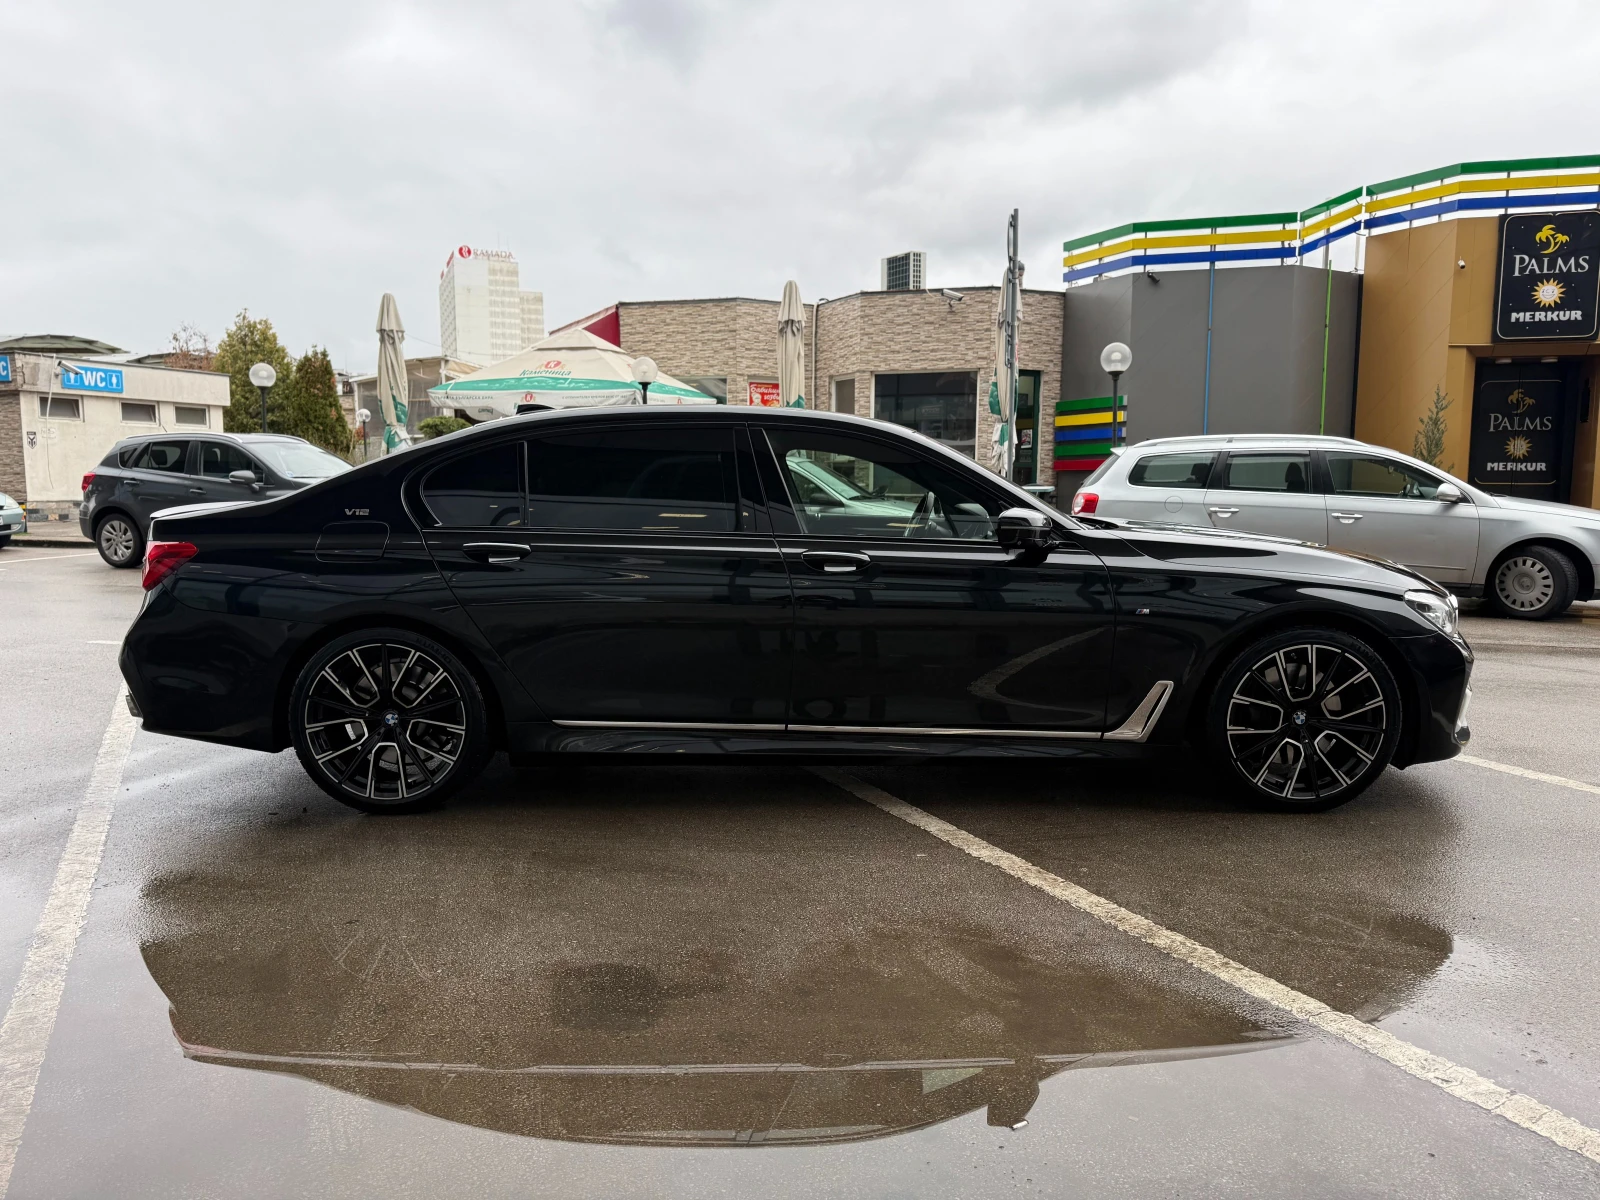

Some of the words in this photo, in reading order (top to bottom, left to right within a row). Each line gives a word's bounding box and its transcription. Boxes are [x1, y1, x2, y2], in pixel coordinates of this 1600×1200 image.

[473, 248, 514, 259] RAMADA
[1512, 254, 1590, 277] PALMS
[1510, 310, 1582, 322] MERKUR
[0, 361, 7, 376] C
[519, 369, 572, 377] Каменица
[82, 370, 106, 387] WC
[1488, 413, 1553, 432] PALMS
[1486, 462, 1547, 471] MERKUR
[344, 508, 370, 516] V12
